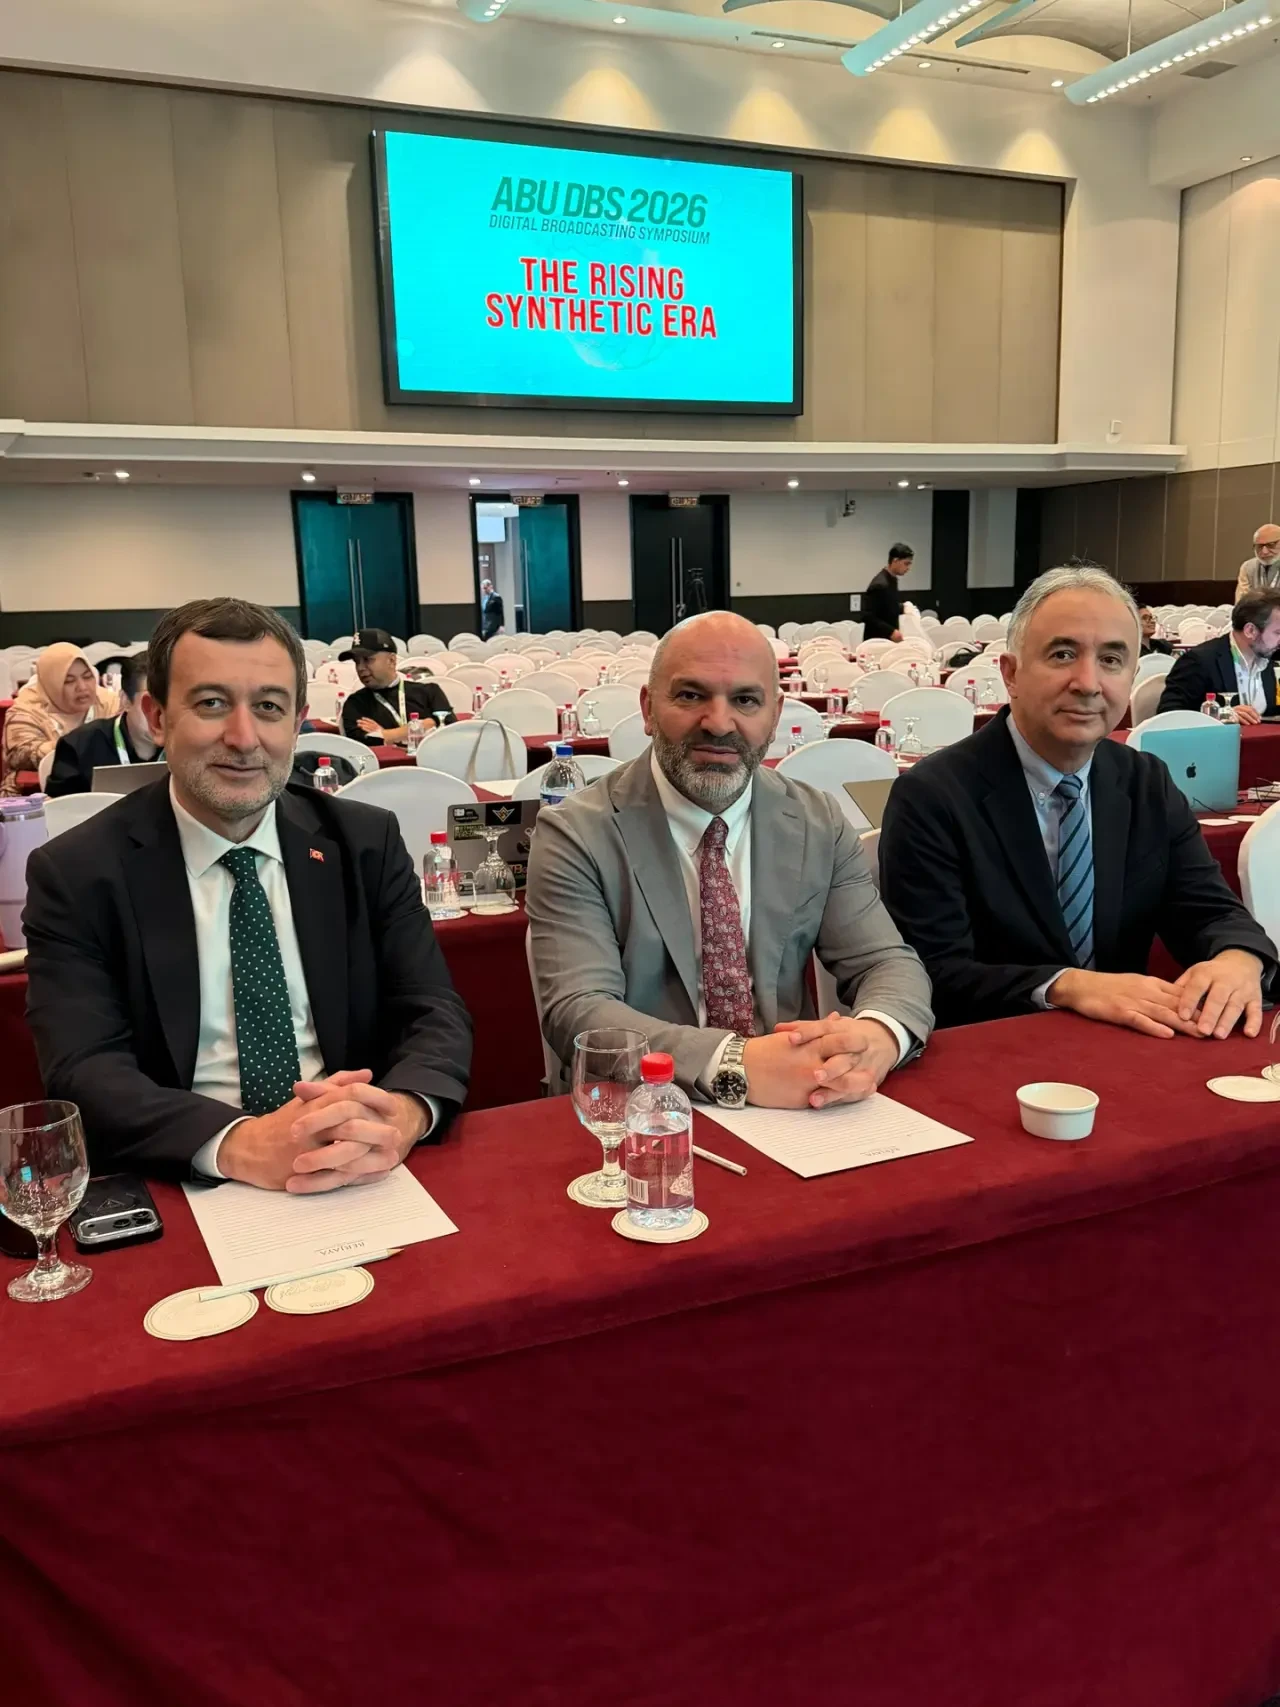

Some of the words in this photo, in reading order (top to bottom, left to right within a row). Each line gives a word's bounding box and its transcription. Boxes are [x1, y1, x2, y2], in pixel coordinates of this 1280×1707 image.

[490, 176, 560, 215] ABU
[562, 182, 626, 221] DBS
[626, 188, 708, 228] 2026
[489, 214, 537, 231] DIGITAL
[541, 218, 636, 239] BROADCASTING
[638, 226, 710, 244] SYMPOSIUM
[520, 257, 578, 294] THE
[589, 262, 684, 301] RISING
[486, 293, 652, 336] SYNTHETIC
[663, 303, 717, 338] ERA
